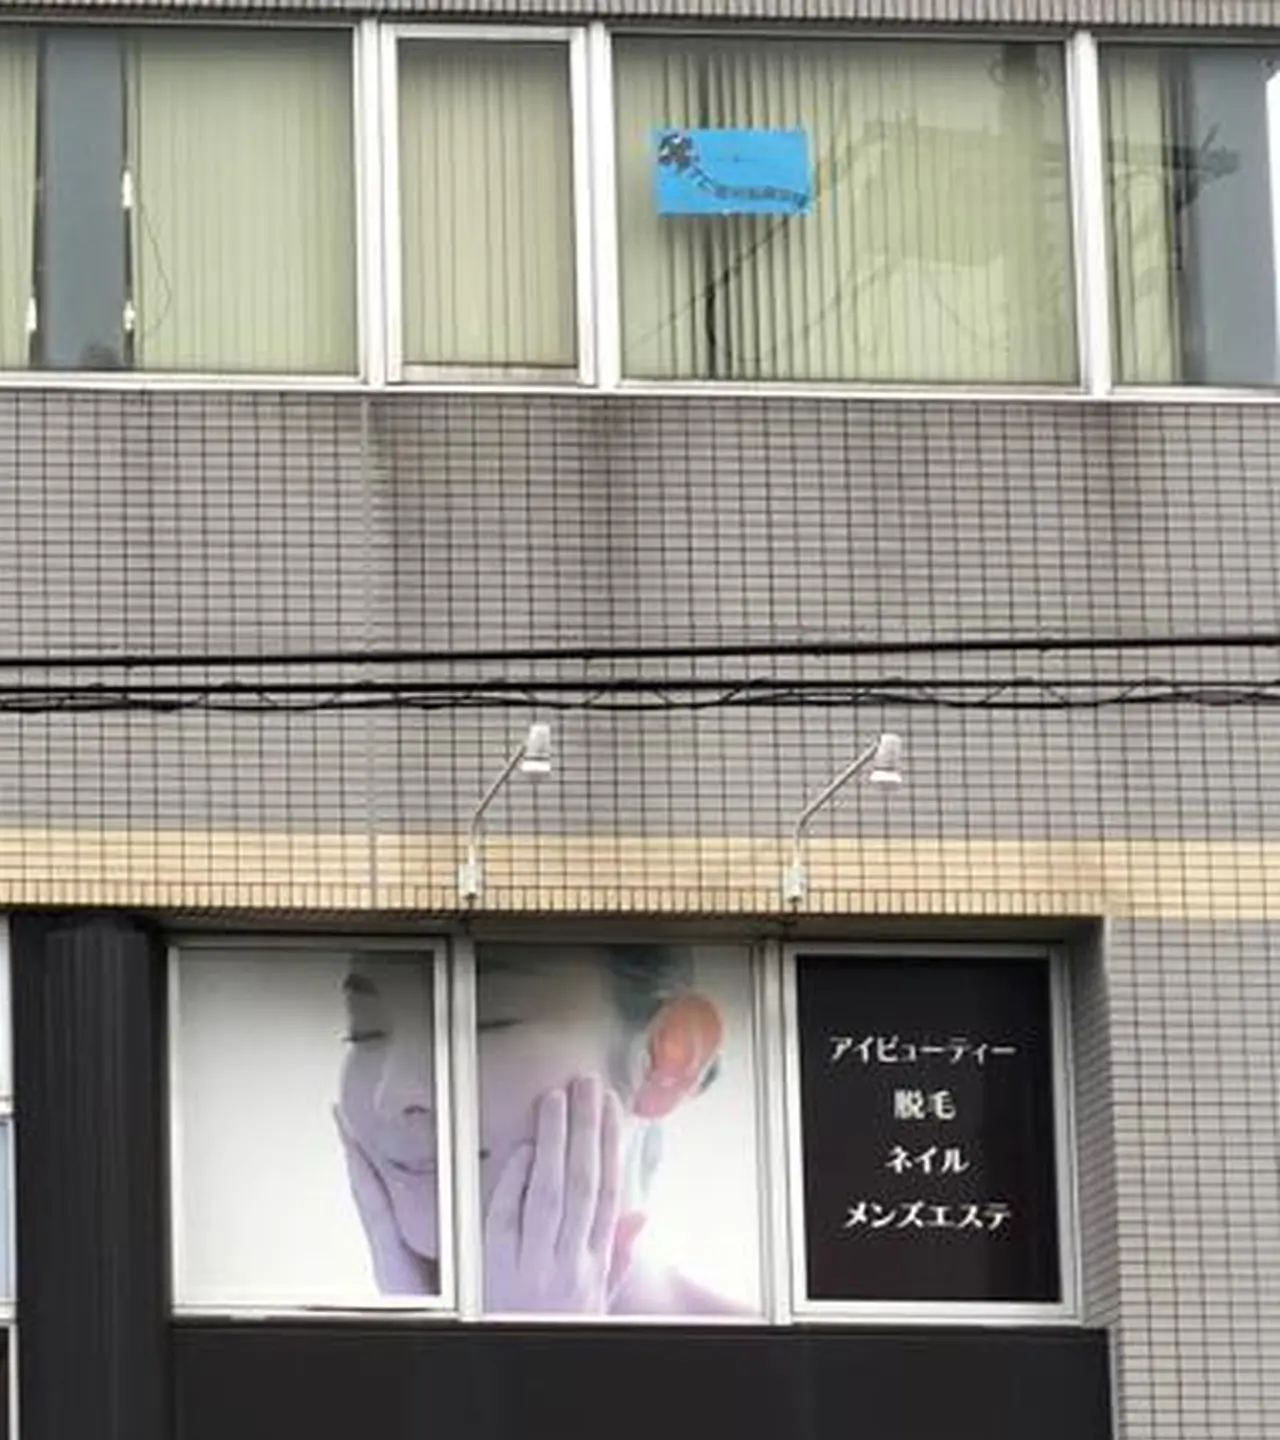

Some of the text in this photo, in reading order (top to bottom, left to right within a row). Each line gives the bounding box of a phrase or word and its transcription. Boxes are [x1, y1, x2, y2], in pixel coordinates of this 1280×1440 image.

[829, 1034, 1017, 1065] アイビューティー
[893, 1088, 957, 1120] 脱毛
[885, 1145, 970, 1175] ネイル
[844, 1200, 1013, 1230] メンズエステ
